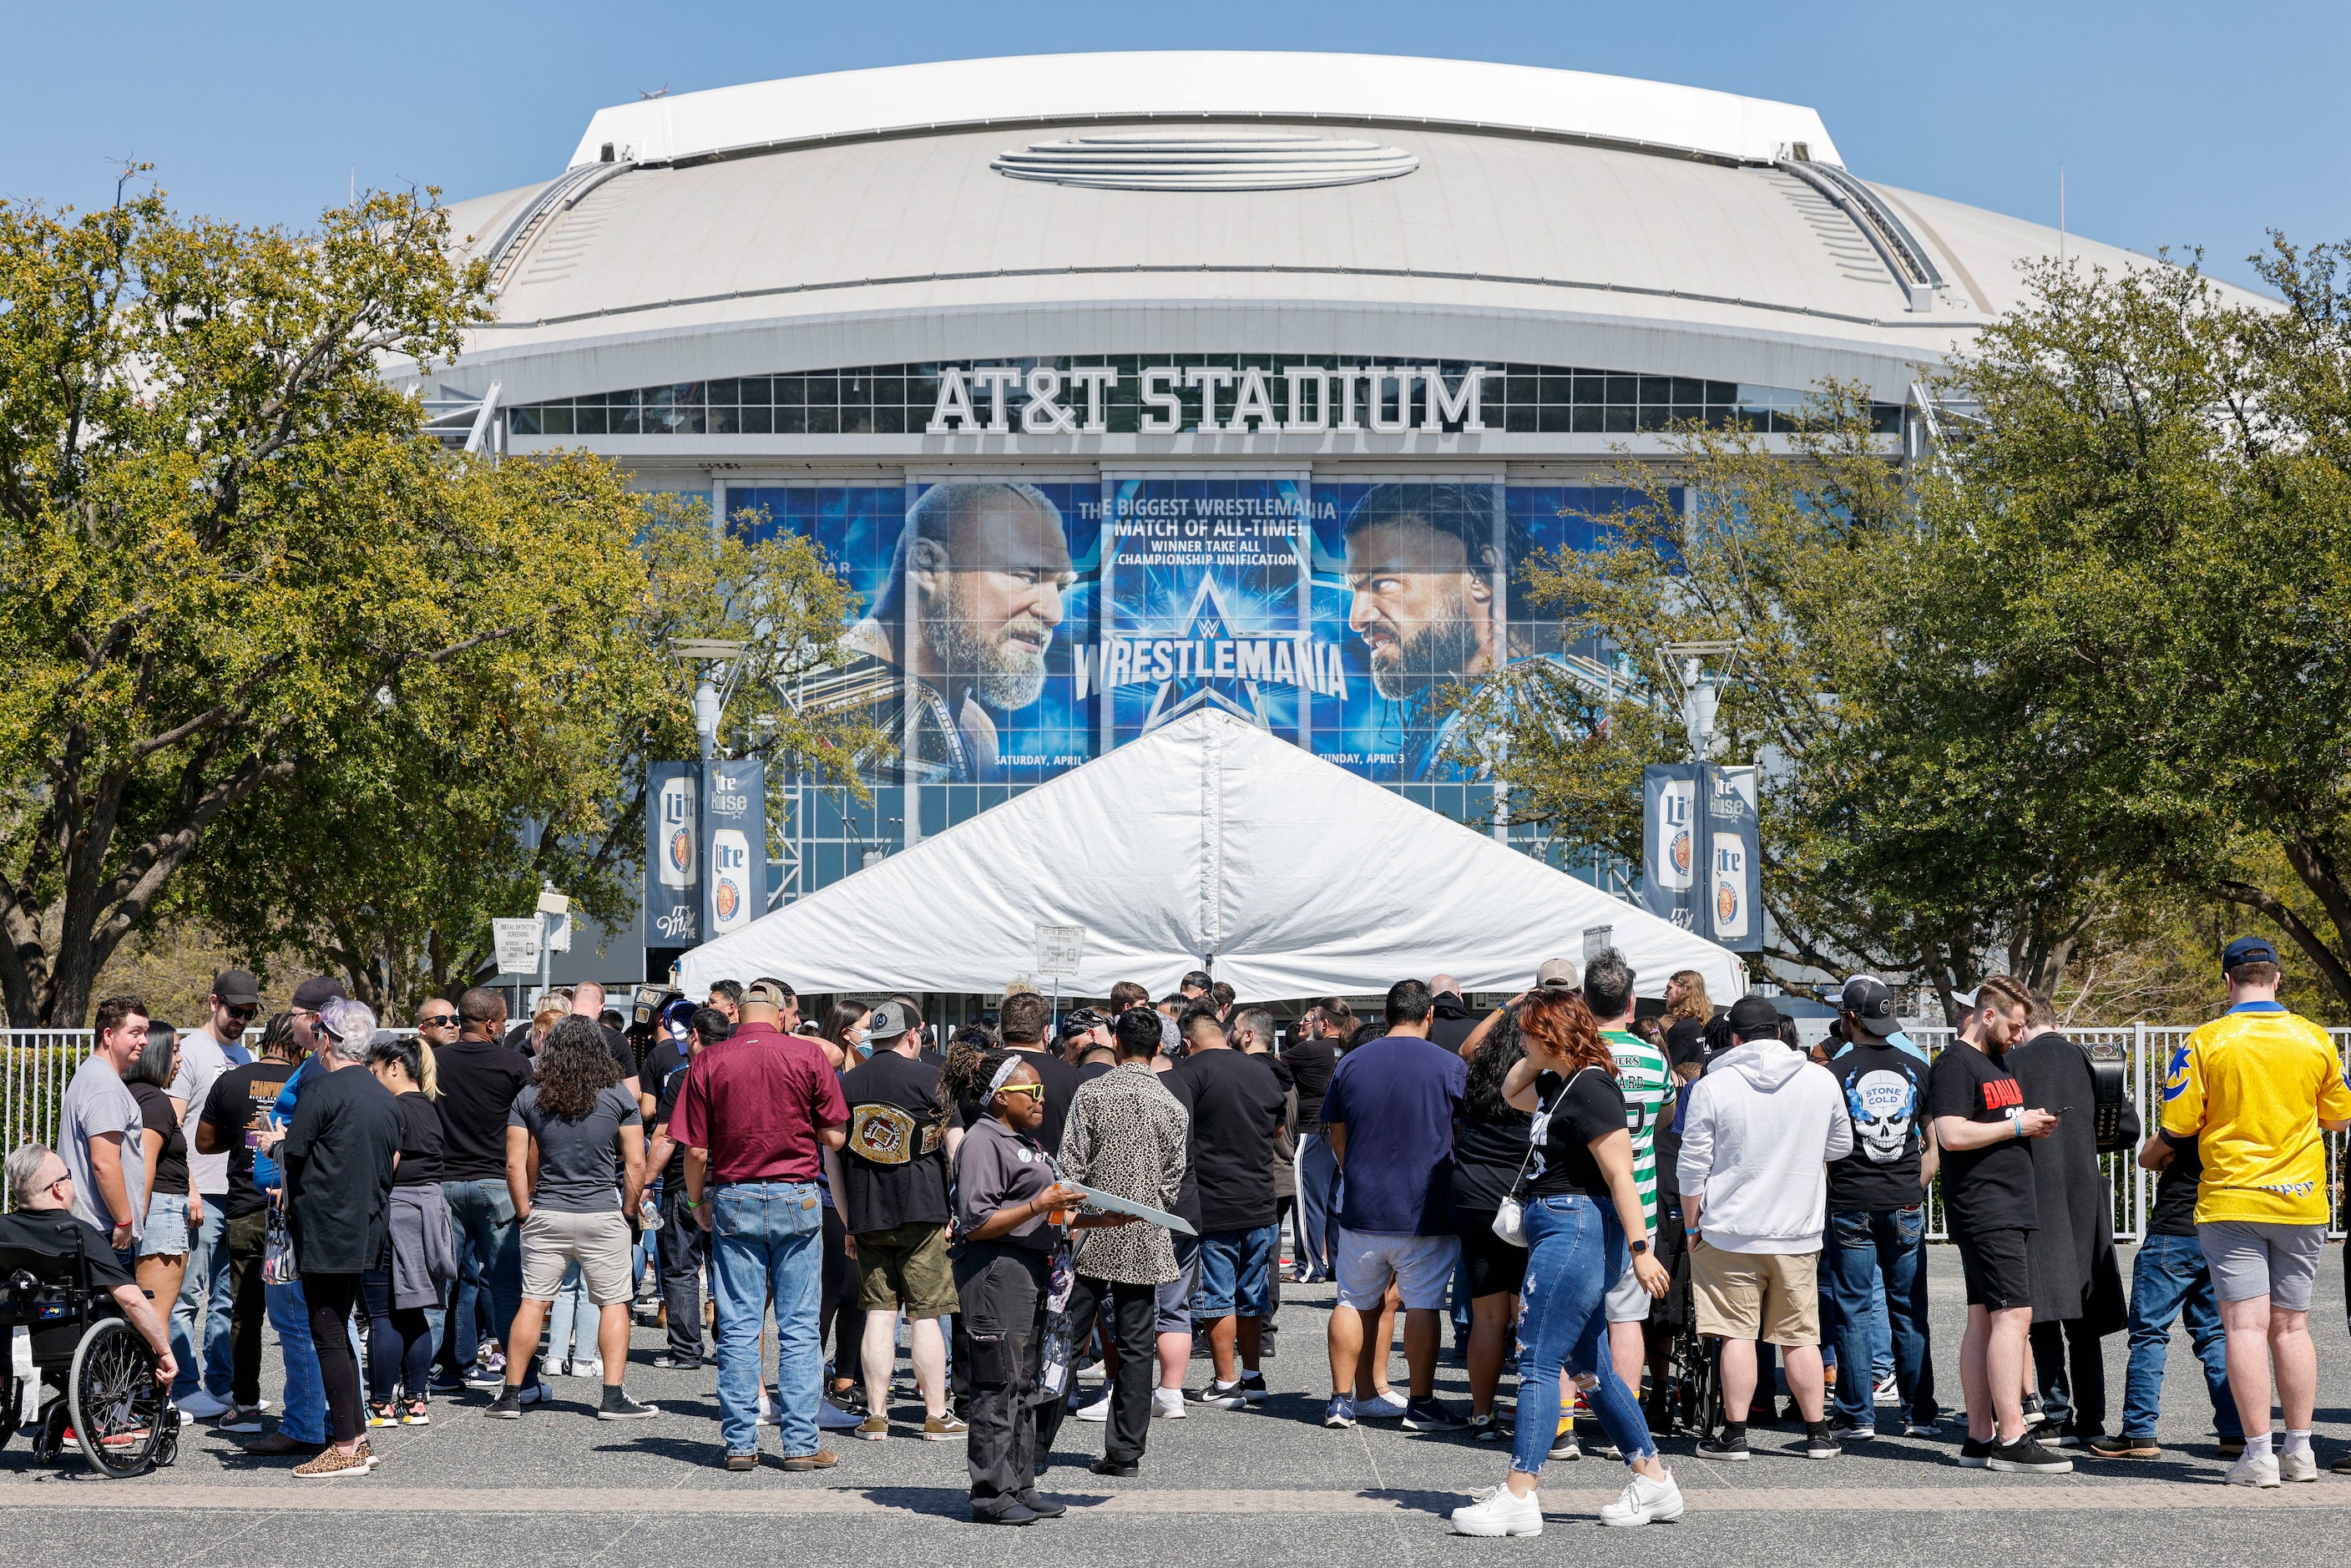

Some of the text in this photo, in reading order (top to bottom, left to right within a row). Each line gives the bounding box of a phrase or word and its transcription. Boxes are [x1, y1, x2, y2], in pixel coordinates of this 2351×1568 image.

[926, 366, 1486, 434] AT&T STADIUM
[1079, 498, 1336, 519] THE BIGGEST WRESTLEMANIA
[1115, 519, 1302, 536] MATCH OF ALL-TIME!
[1151, 541, 1261, 552] WINNER TAKE ALL
[1118, 554, 1297, 566] CHAMPIONSHIP UNIFICATION
[1074, 640, 1348, 701] WRESTLEMANIA
[994, 755, 1049, 766] SATURDAY,
[1054, 756, 1083, 766] APRIL
[1366, 753, 1396, 763] APRIL
[1398, 753, 1405, 764] 3
[715, 843, 743, 874] Lite
[1866, 1088, 1902, 1098] STONE
[1869, 1096, 1898, 1105] COLD
